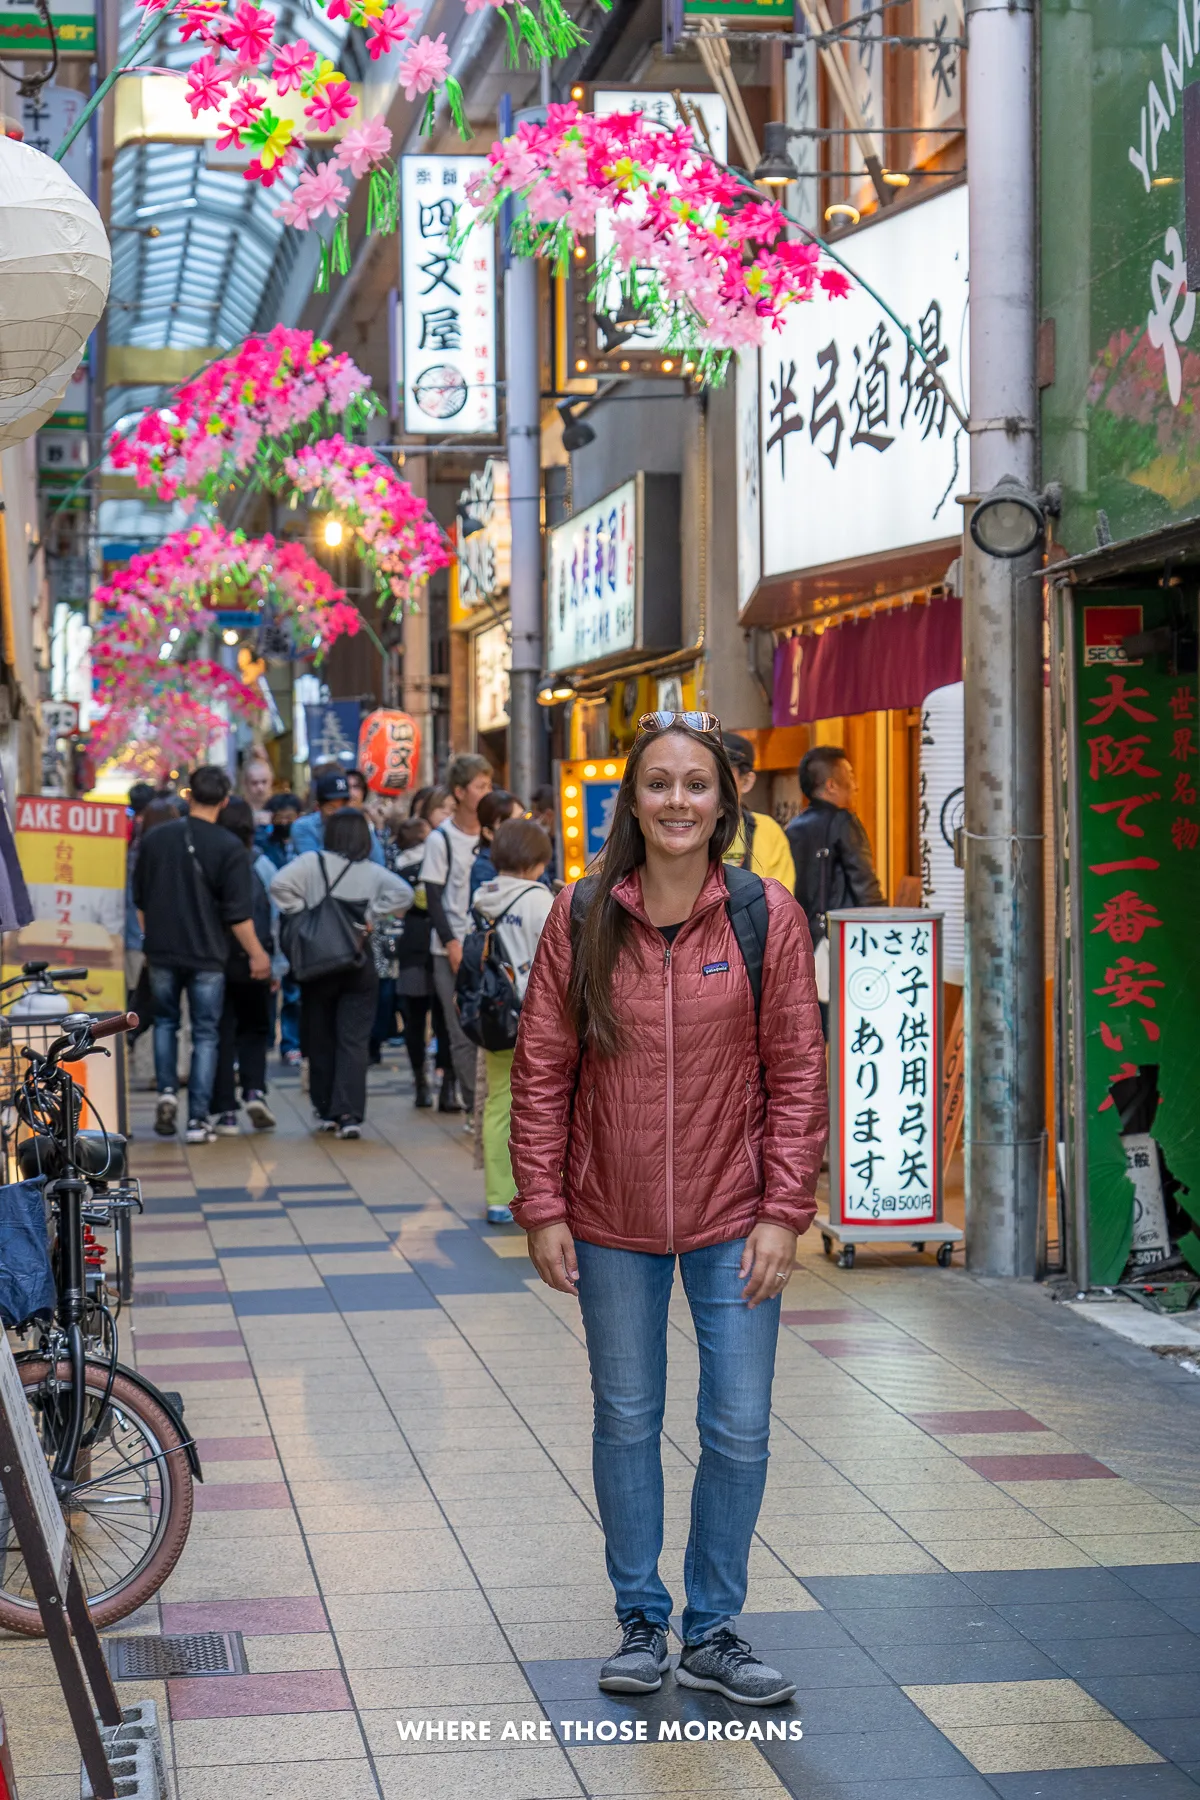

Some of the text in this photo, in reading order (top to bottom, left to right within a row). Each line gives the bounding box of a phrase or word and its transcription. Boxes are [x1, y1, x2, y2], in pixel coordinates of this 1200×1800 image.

[418, 197, 461, 350] 四文屋
[767, 300, 949, 481] 半弓道場
[1088, 647, 1127, 660] SECO
[17, 802, 120, 833] AKE OUT
[1168, 686, 1199, 850] 世界名物
[850, 926, 930, 958] 小さな
[851, 1016, 884, 1190] あります
[897, 966, 930, 1190] 子供用弓矢
